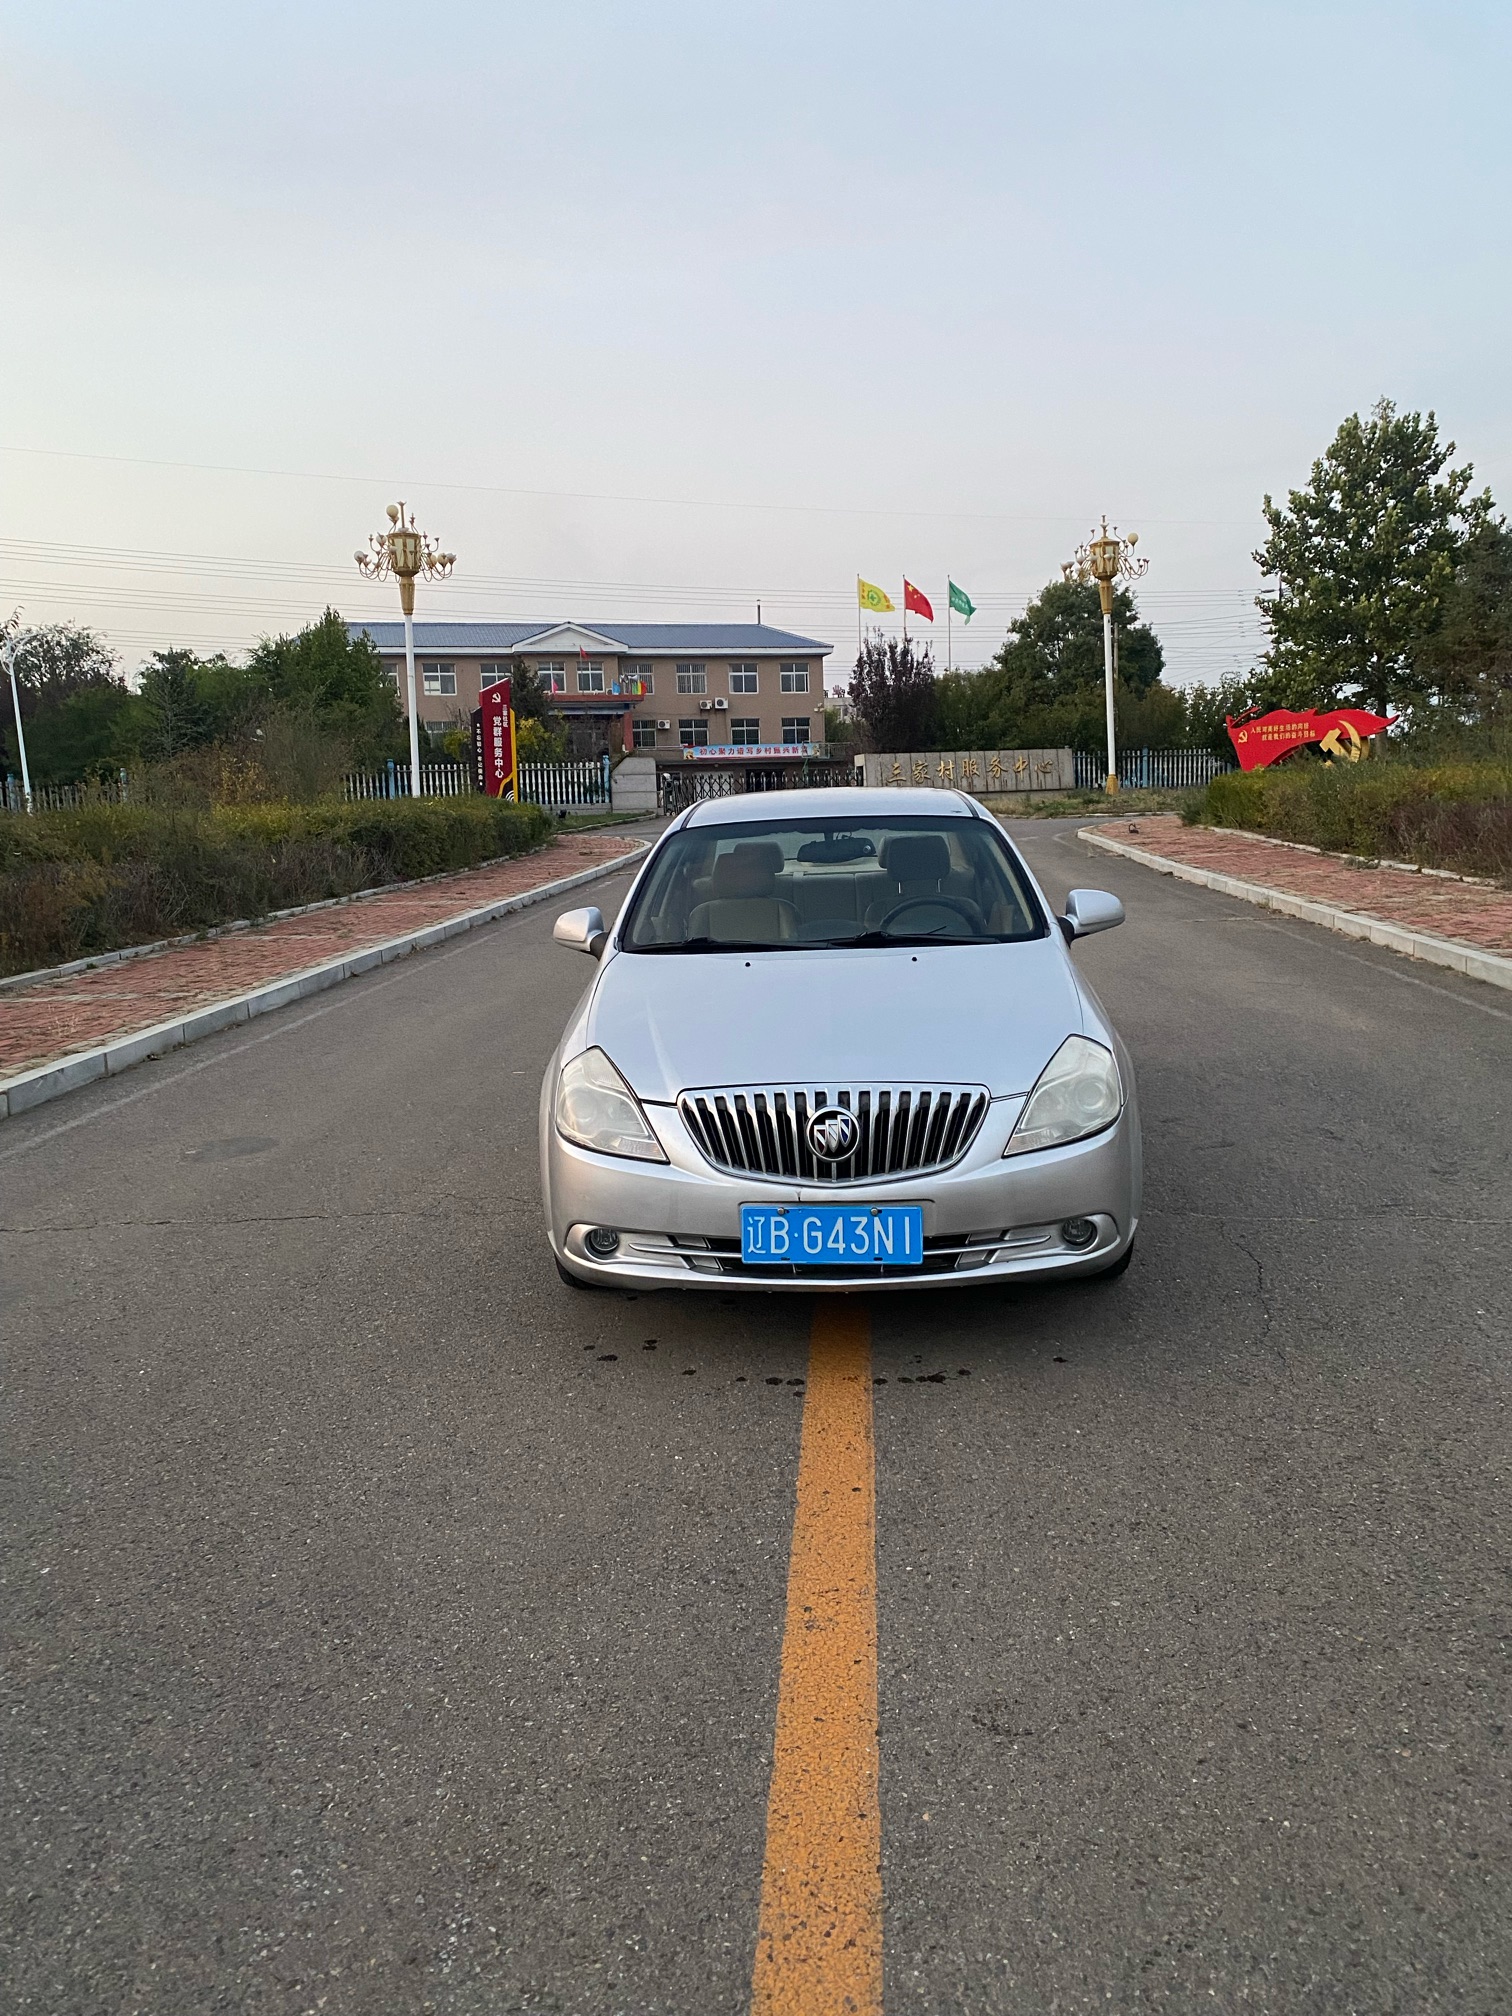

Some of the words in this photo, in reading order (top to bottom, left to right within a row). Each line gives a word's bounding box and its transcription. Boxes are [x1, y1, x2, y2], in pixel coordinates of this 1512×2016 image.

[493, 716, 504, 778] 党群服务中心
[887, 755, 1053, 785] 三家村服务中心
